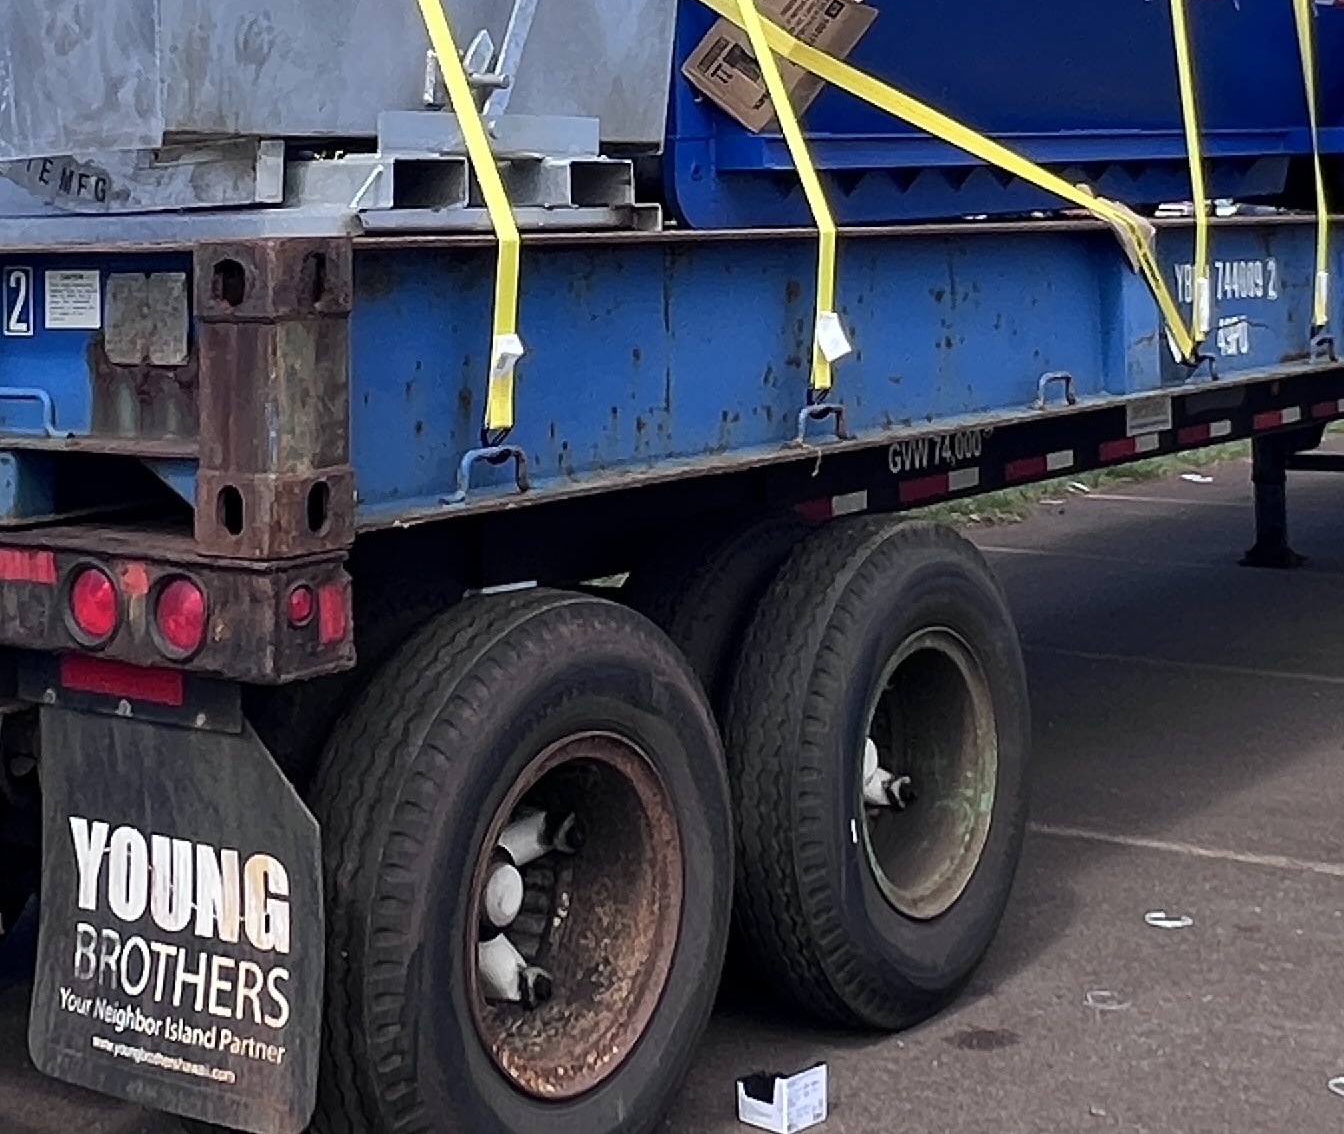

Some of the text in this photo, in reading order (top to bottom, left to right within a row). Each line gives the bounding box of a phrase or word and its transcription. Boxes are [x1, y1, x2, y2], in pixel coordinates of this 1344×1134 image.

[9, 271, 28, 332] 2
[888, 430, 983, 474] GVW 74,000
[69, 816, 290, 954] YOUNG
[74, 922, 290, 1030] BROTHERS
[59, 987, 286, 1064] Your Neighbor Island Partner
